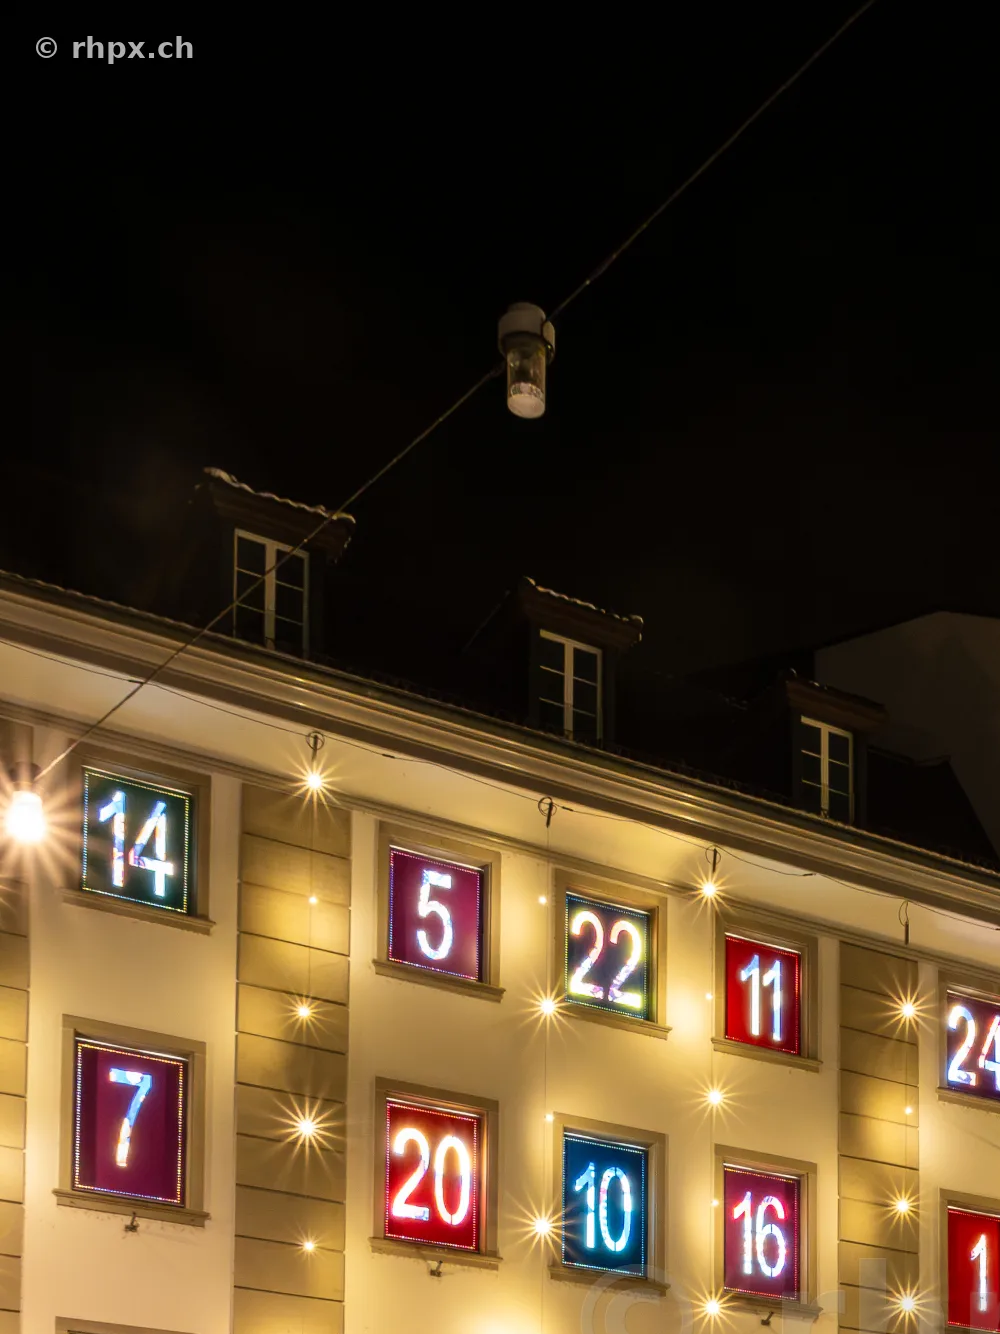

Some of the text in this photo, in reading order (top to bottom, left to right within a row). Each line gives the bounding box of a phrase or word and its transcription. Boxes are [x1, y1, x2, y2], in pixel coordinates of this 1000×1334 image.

[97, 790, 176, 898] 14
[415, 870, 457, 960] 5
[569, 908, 647, 1001] 22
[739, 955, 784, 1042] 11
[110, 1068, 151, 1167] 7
[391, 1127, 472, 1227] 20
[574, 1162, 635, 1253] 10
[731, 1191, 790, 1278] 16
[970, 1234, 990, 1312] 1
